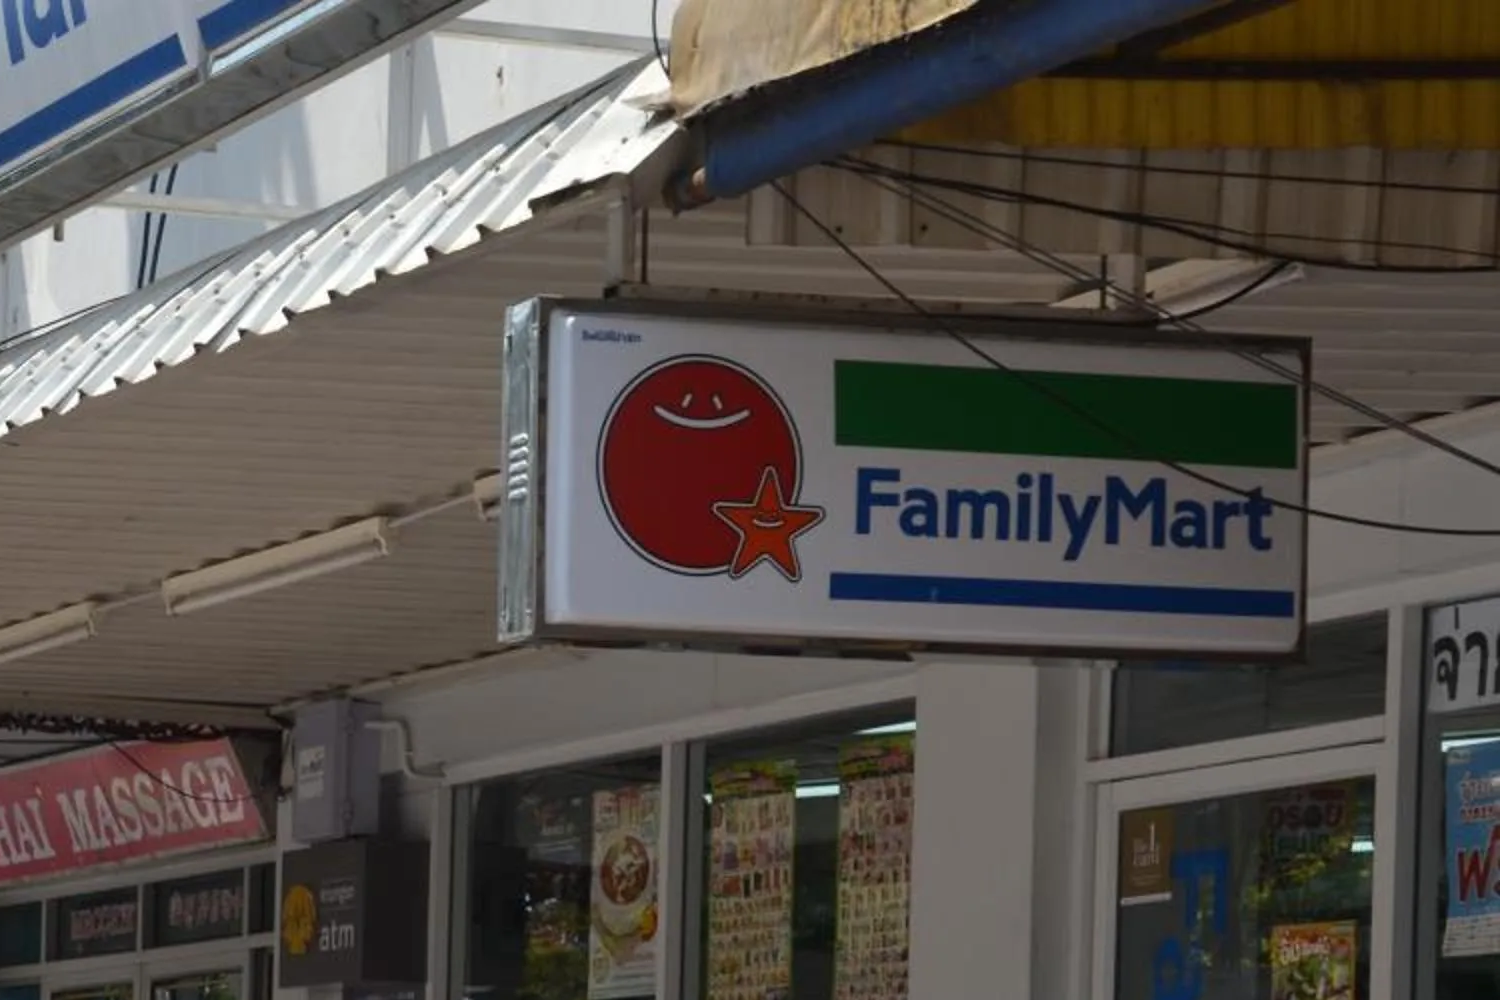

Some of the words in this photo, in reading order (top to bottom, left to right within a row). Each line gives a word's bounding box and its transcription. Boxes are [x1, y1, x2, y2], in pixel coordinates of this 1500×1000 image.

[855, 467, 1274, 561] FamilyMart
[56, 756, 245, 852] MASSAGE
[318, 919, 356, 952] atm
